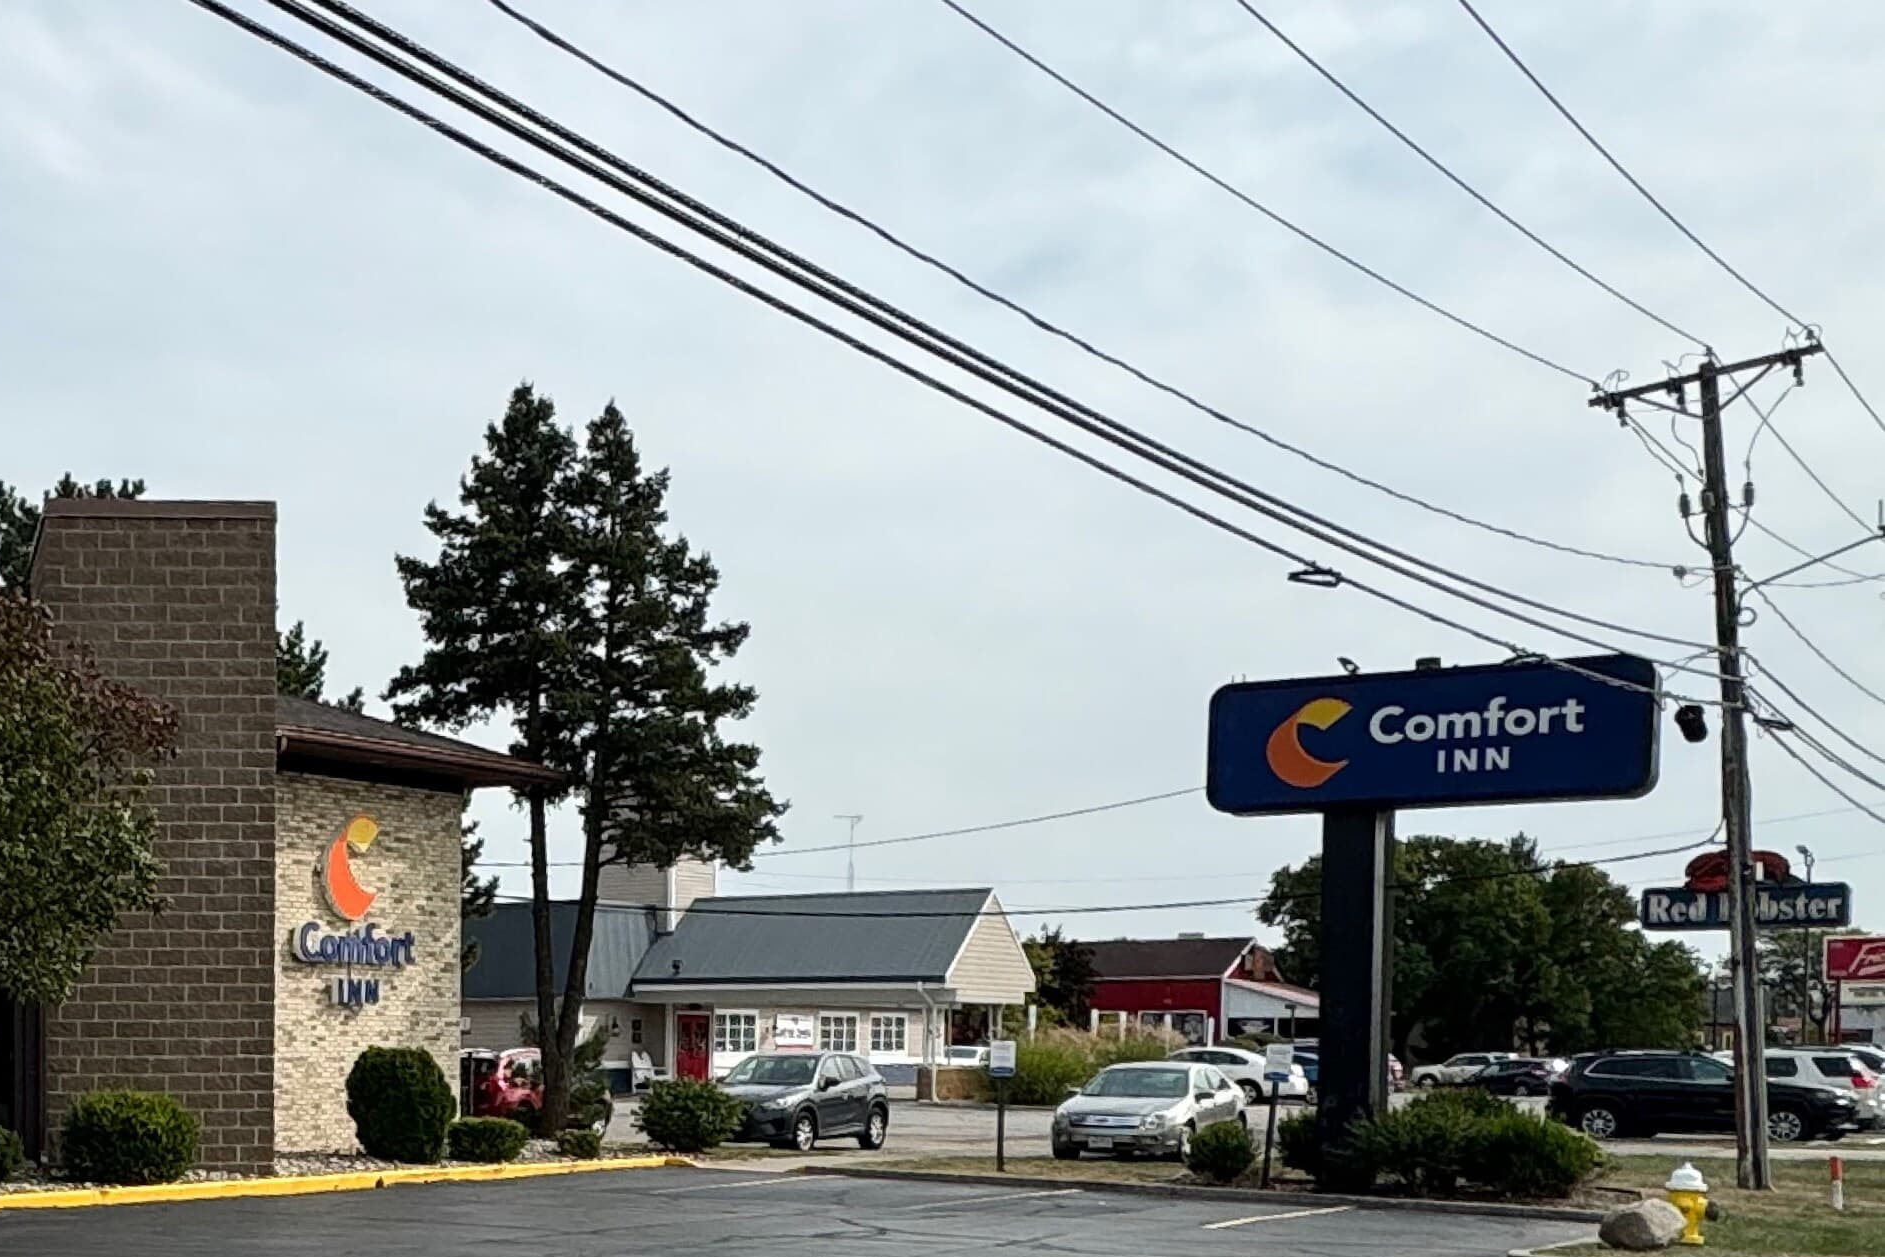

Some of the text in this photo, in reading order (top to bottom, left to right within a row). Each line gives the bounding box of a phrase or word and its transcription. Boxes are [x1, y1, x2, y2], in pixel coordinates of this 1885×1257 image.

[1370, 697, 1585, 744] Comfort
[1437, 746, 1511, 773] INN
[1648, 892, 1842, 924] Red Lbster
[295, 921, 415, 966] Comfort
[334, 978, 379, 1006] INN
